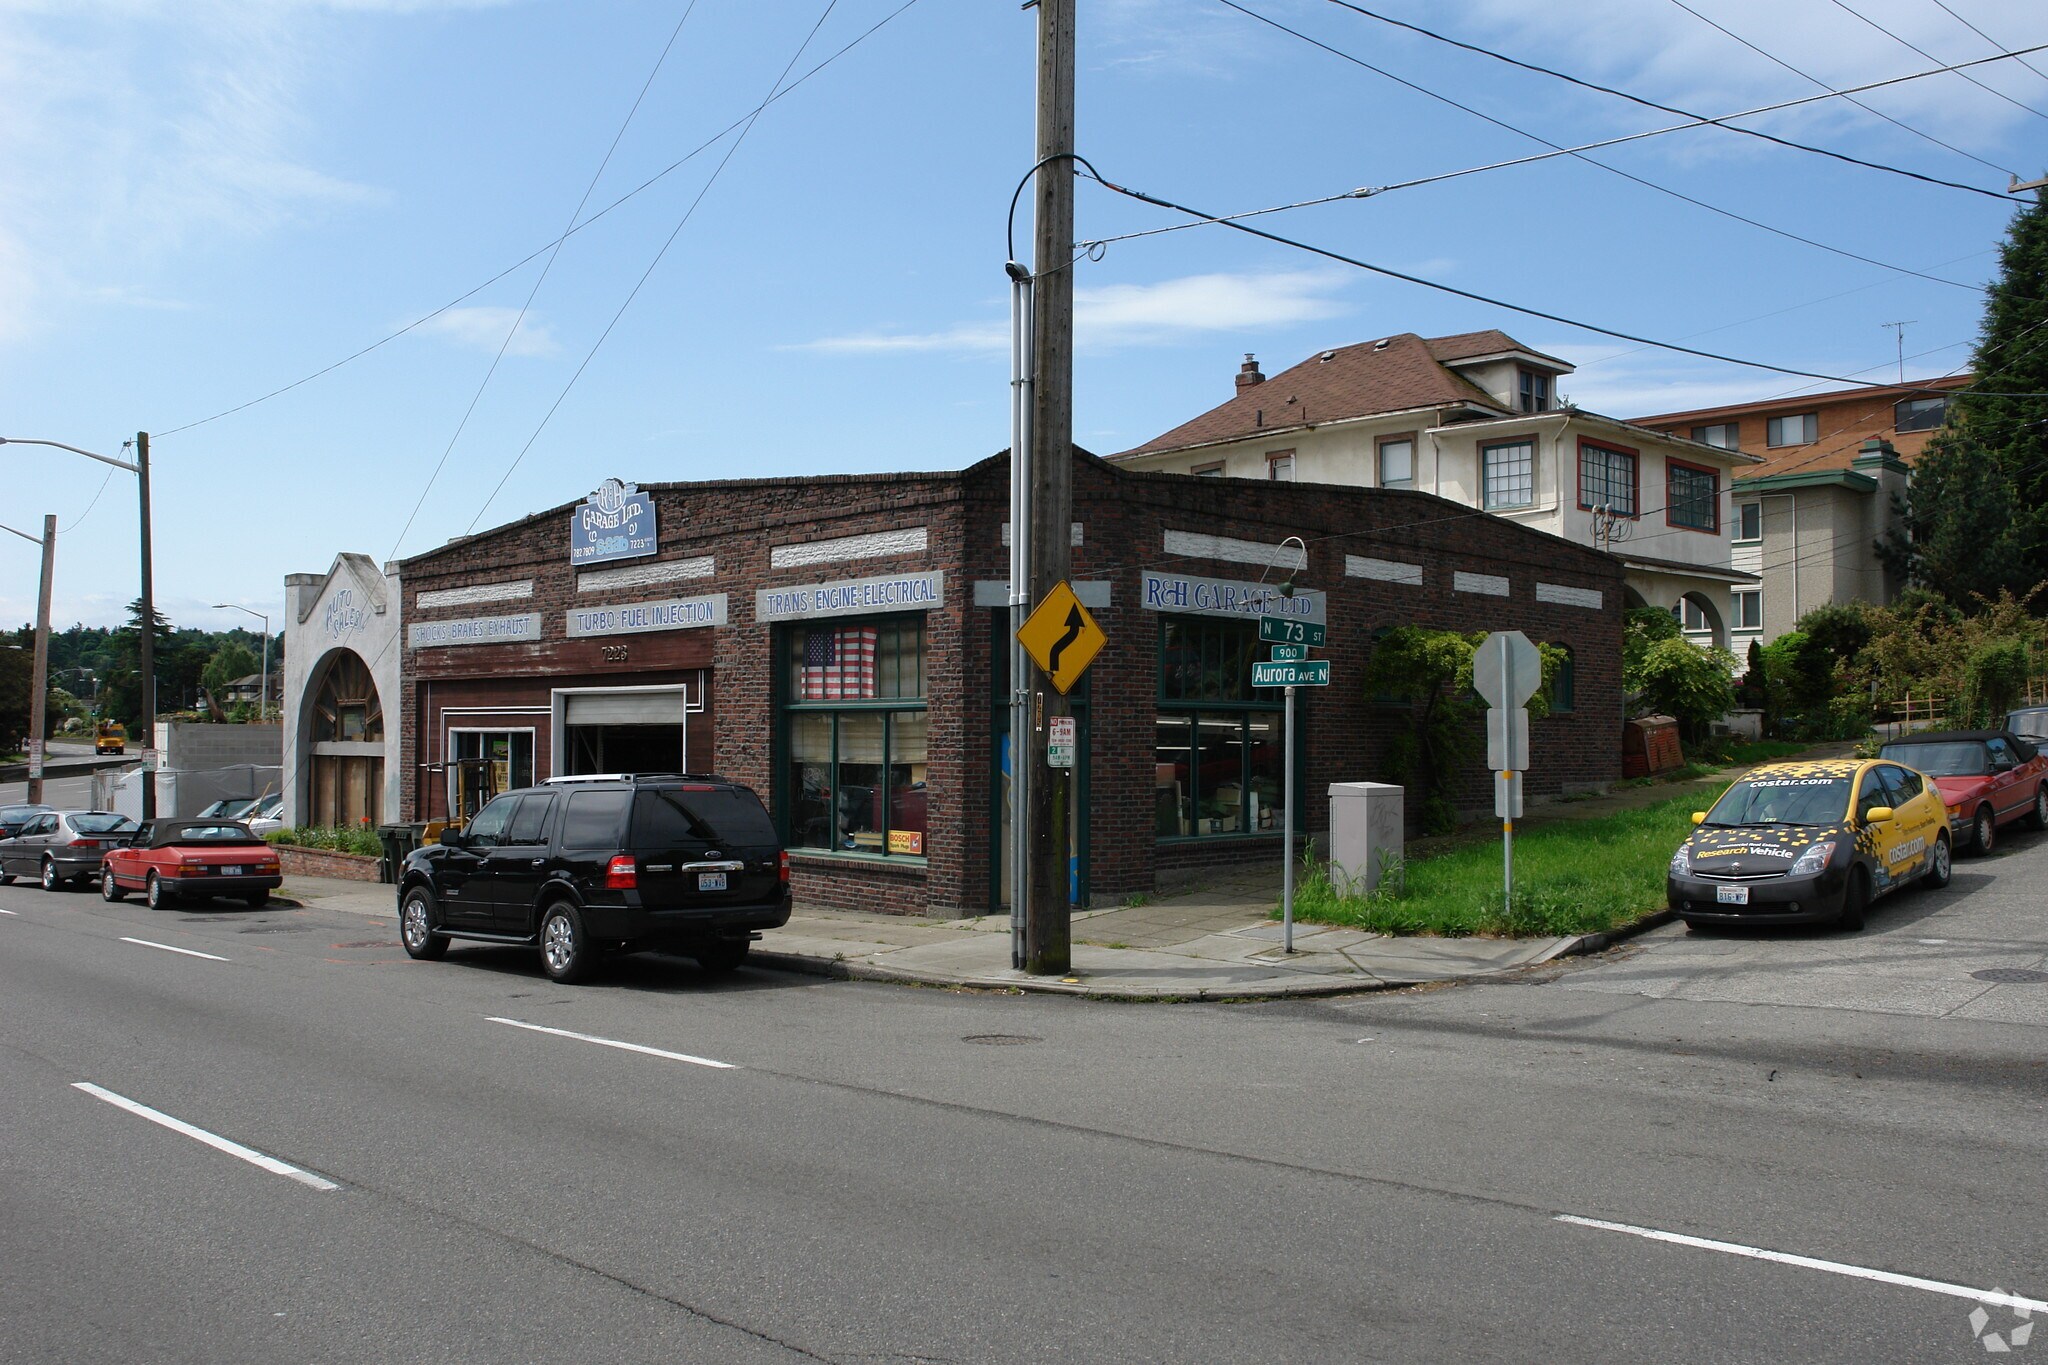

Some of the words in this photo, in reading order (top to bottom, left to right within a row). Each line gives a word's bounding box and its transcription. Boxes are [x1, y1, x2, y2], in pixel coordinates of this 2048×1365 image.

[600, 483, 623, 509] R&H
[583, 508, 620, 531] GARAGE
[622, 503, 643, 525] LTD.
[630, 538, 645, 550] 7223
[767, 592, 808, 615] TRANS
[815, 586, 858, 610] ENGINE
[863, 578, 937, 606] ELECTRICAL
[1147, 577, 1189, 608] R&H
[1194, 583, 1272, 614] GARAGE
[1280, 596, 1312, 615] LTD
[325, 588, 352, 634] AUTO
[577, 611, 615, 631] TURBO
[621, 608, 649, 628] FUEL
[652, 601, 714, 625] INJECTION
[416, 625, 447, 642] SHOCKS
[452, 621, 484, 639] BRAKES
[488, 617, 530, 636] EXHAUST
[1264, 621, 1272, 635] N
[1283, 621, 1304, 642] 73
[1313, 632, 1322, 642] ST
[601, 645, 628, 661] 7223
[1280, 648, 1298, 658] 900
[1255, 664, 1295, 683] Aurora
[1298, 671, 1315, 681] AVE
[1319, 668, 1327, 681] N
[1749, 778, 1833, 788] costar.com
[890, 833, 910, 843] BOSCH
[1696, 847, 1748, 859] Research
[1750, 847, 1794, 859] Vehicle
[1889, 836, 1925, 864] costar.com
